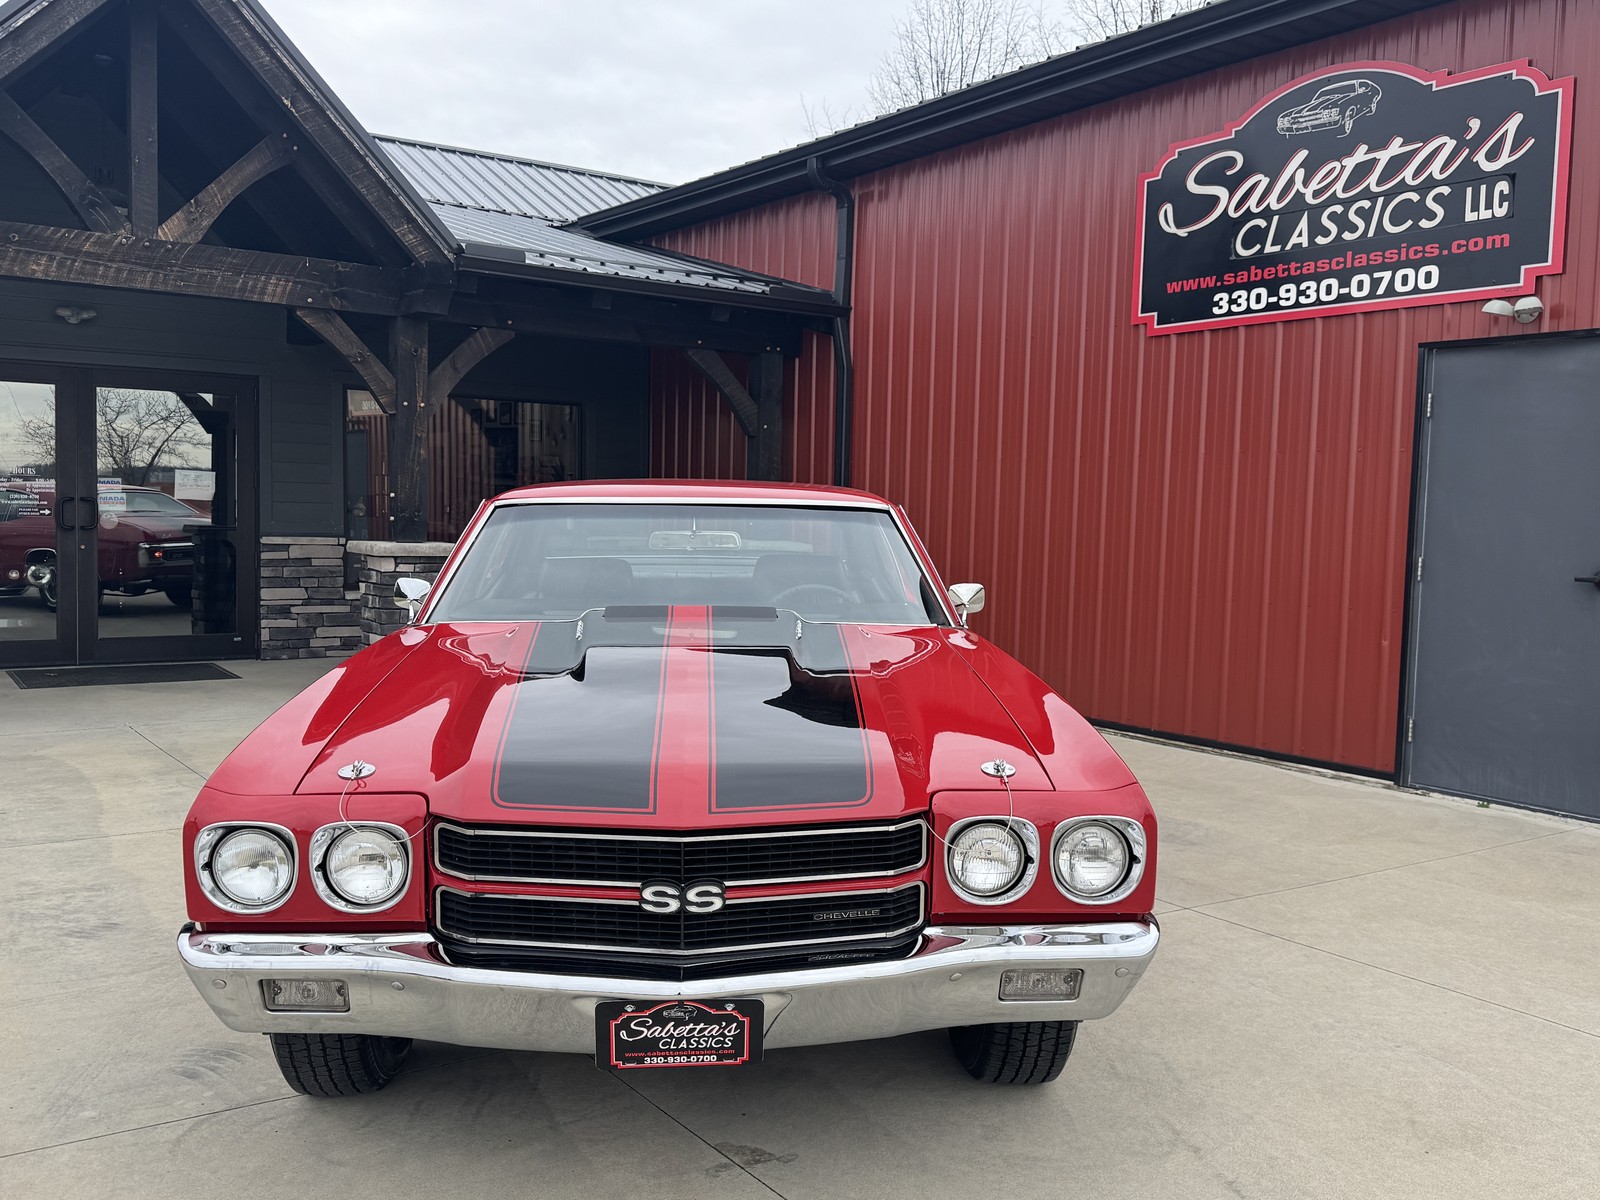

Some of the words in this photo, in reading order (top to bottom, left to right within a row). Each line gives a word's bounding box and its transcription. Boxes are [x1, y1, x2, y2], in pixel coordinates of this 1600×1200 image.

[1158, 111, 1535, 237] Sabetta's
[1235, 185, 1452, 257] CLASSICS
[1464, 180, 1510, 223] LLC
[1166, 233, 1510, 294] www.sabettasclassics.com
[1212, 264, 1440, 315] 330-930-0700
[640, 884, 725, 914] SS
[813, 909, 880, 920] CHEVELLE
[619, 1018, 741, 1042] Sabetta's
[659, 1037, 734, 1050] CLASSICS
[624, 1049, 736, 1058] www.sabettasclassics.com
[644, 1055, 717, 1064] 330-930-0700
